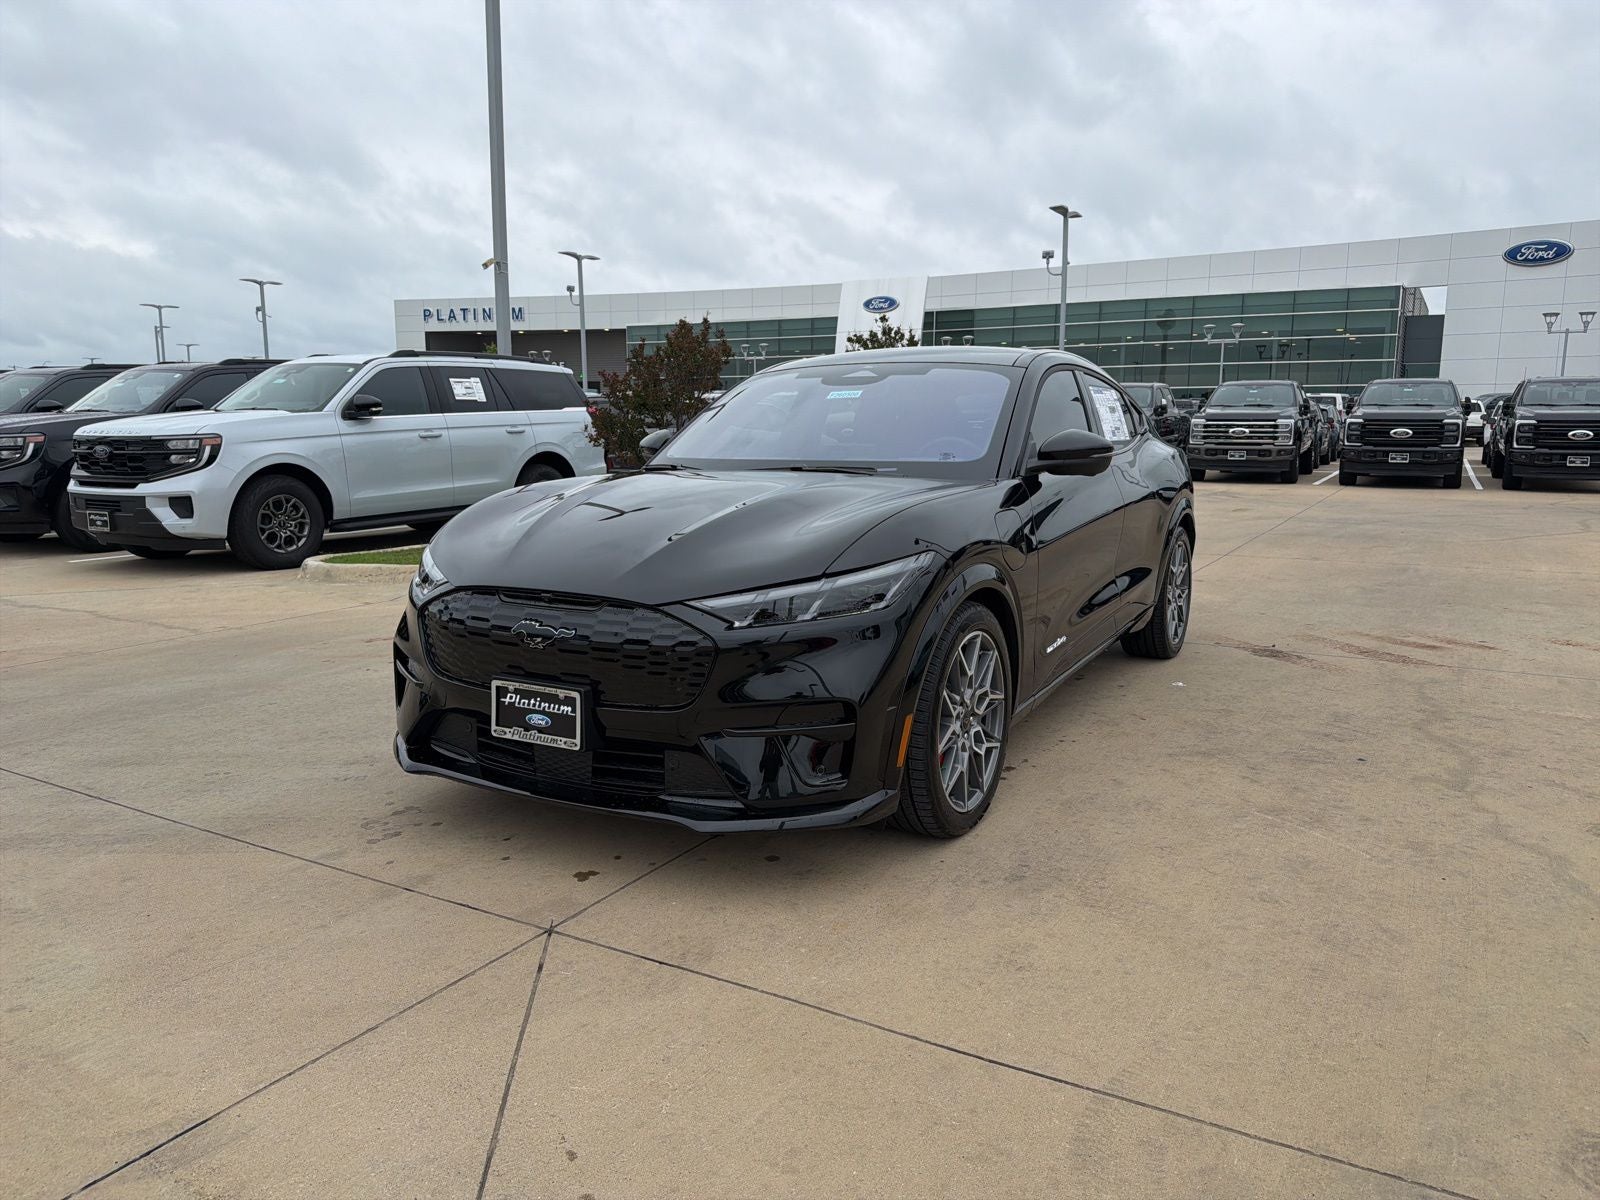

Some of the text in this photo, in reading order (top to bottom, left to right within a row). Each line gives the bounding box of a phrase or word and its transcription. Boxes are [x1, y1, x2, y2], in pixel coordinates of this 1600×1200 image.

[1516, 244, 1558, 261] Ford
[868, 298, 891, 309] Ford
[423, 306, 525, 323] PLATINM
[500, 693, 576, 716] Platinum
[511, 728, 562, 746] Platinum
